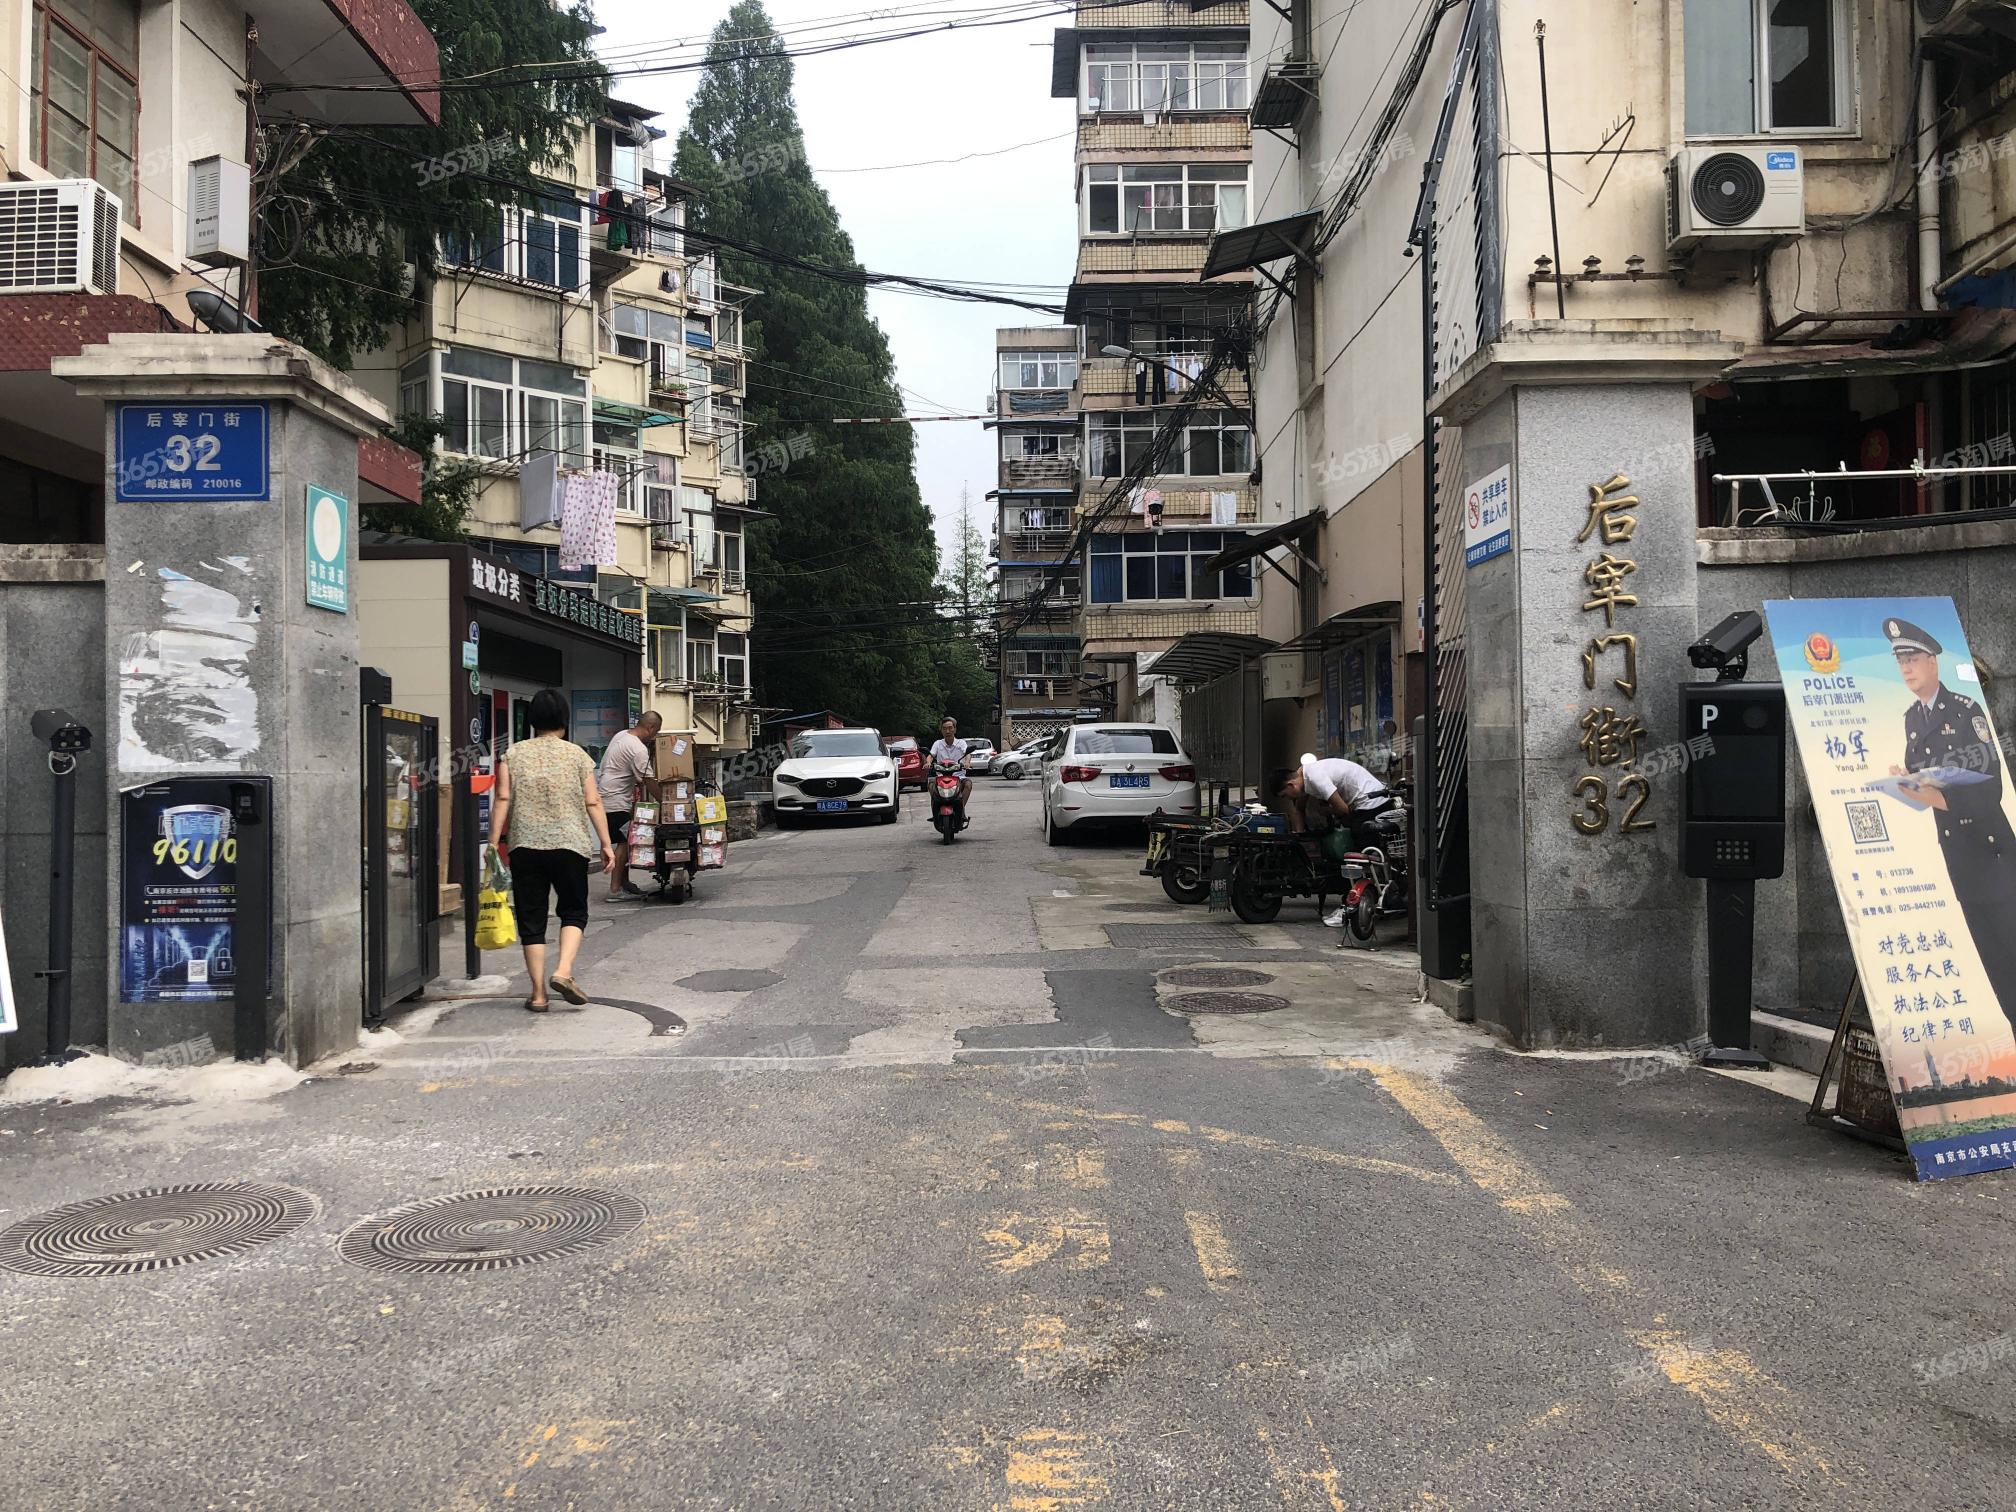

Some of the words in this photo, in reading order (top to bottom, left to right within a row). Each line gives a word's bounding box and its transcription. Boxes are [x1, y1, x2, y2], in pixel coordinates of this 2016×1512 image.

[146, 412, 240, 428] 后宰门街
[167, 434, 221, 472] 32
[145, 478, 192, 490] 邮政编码
[203, 479, 242, 489] 210016
[1482, 477, 1507, 505] 共享单车
[1482, 500, 1507, 527] 禁止入内
[471, 557, 521, 603] 垃圾分类
[1577, 474, 1648, 772] 后宰门街
[1802, 677, 1856, 691] POLICE
[1802, 691, 1865, 707] 后宰门派出所
[1702, 705, 1719, 730] P
[1824, 730, 1869, 762] 杨军
[1836, 765, 1855, 773] Yang
[1856, 763, 1869, 771] Jun
[1570, 774, 1657, 836] 32
[153, 838, 237, 865] 96110
[1879, 929, 1953, 955] 对党忠诚
[1886, 959, 1960, 983] 服务人民
[1894, 989, 1968, 1014] 执法公正
[1902, 1017, 1974, 1044] 纪律严明
